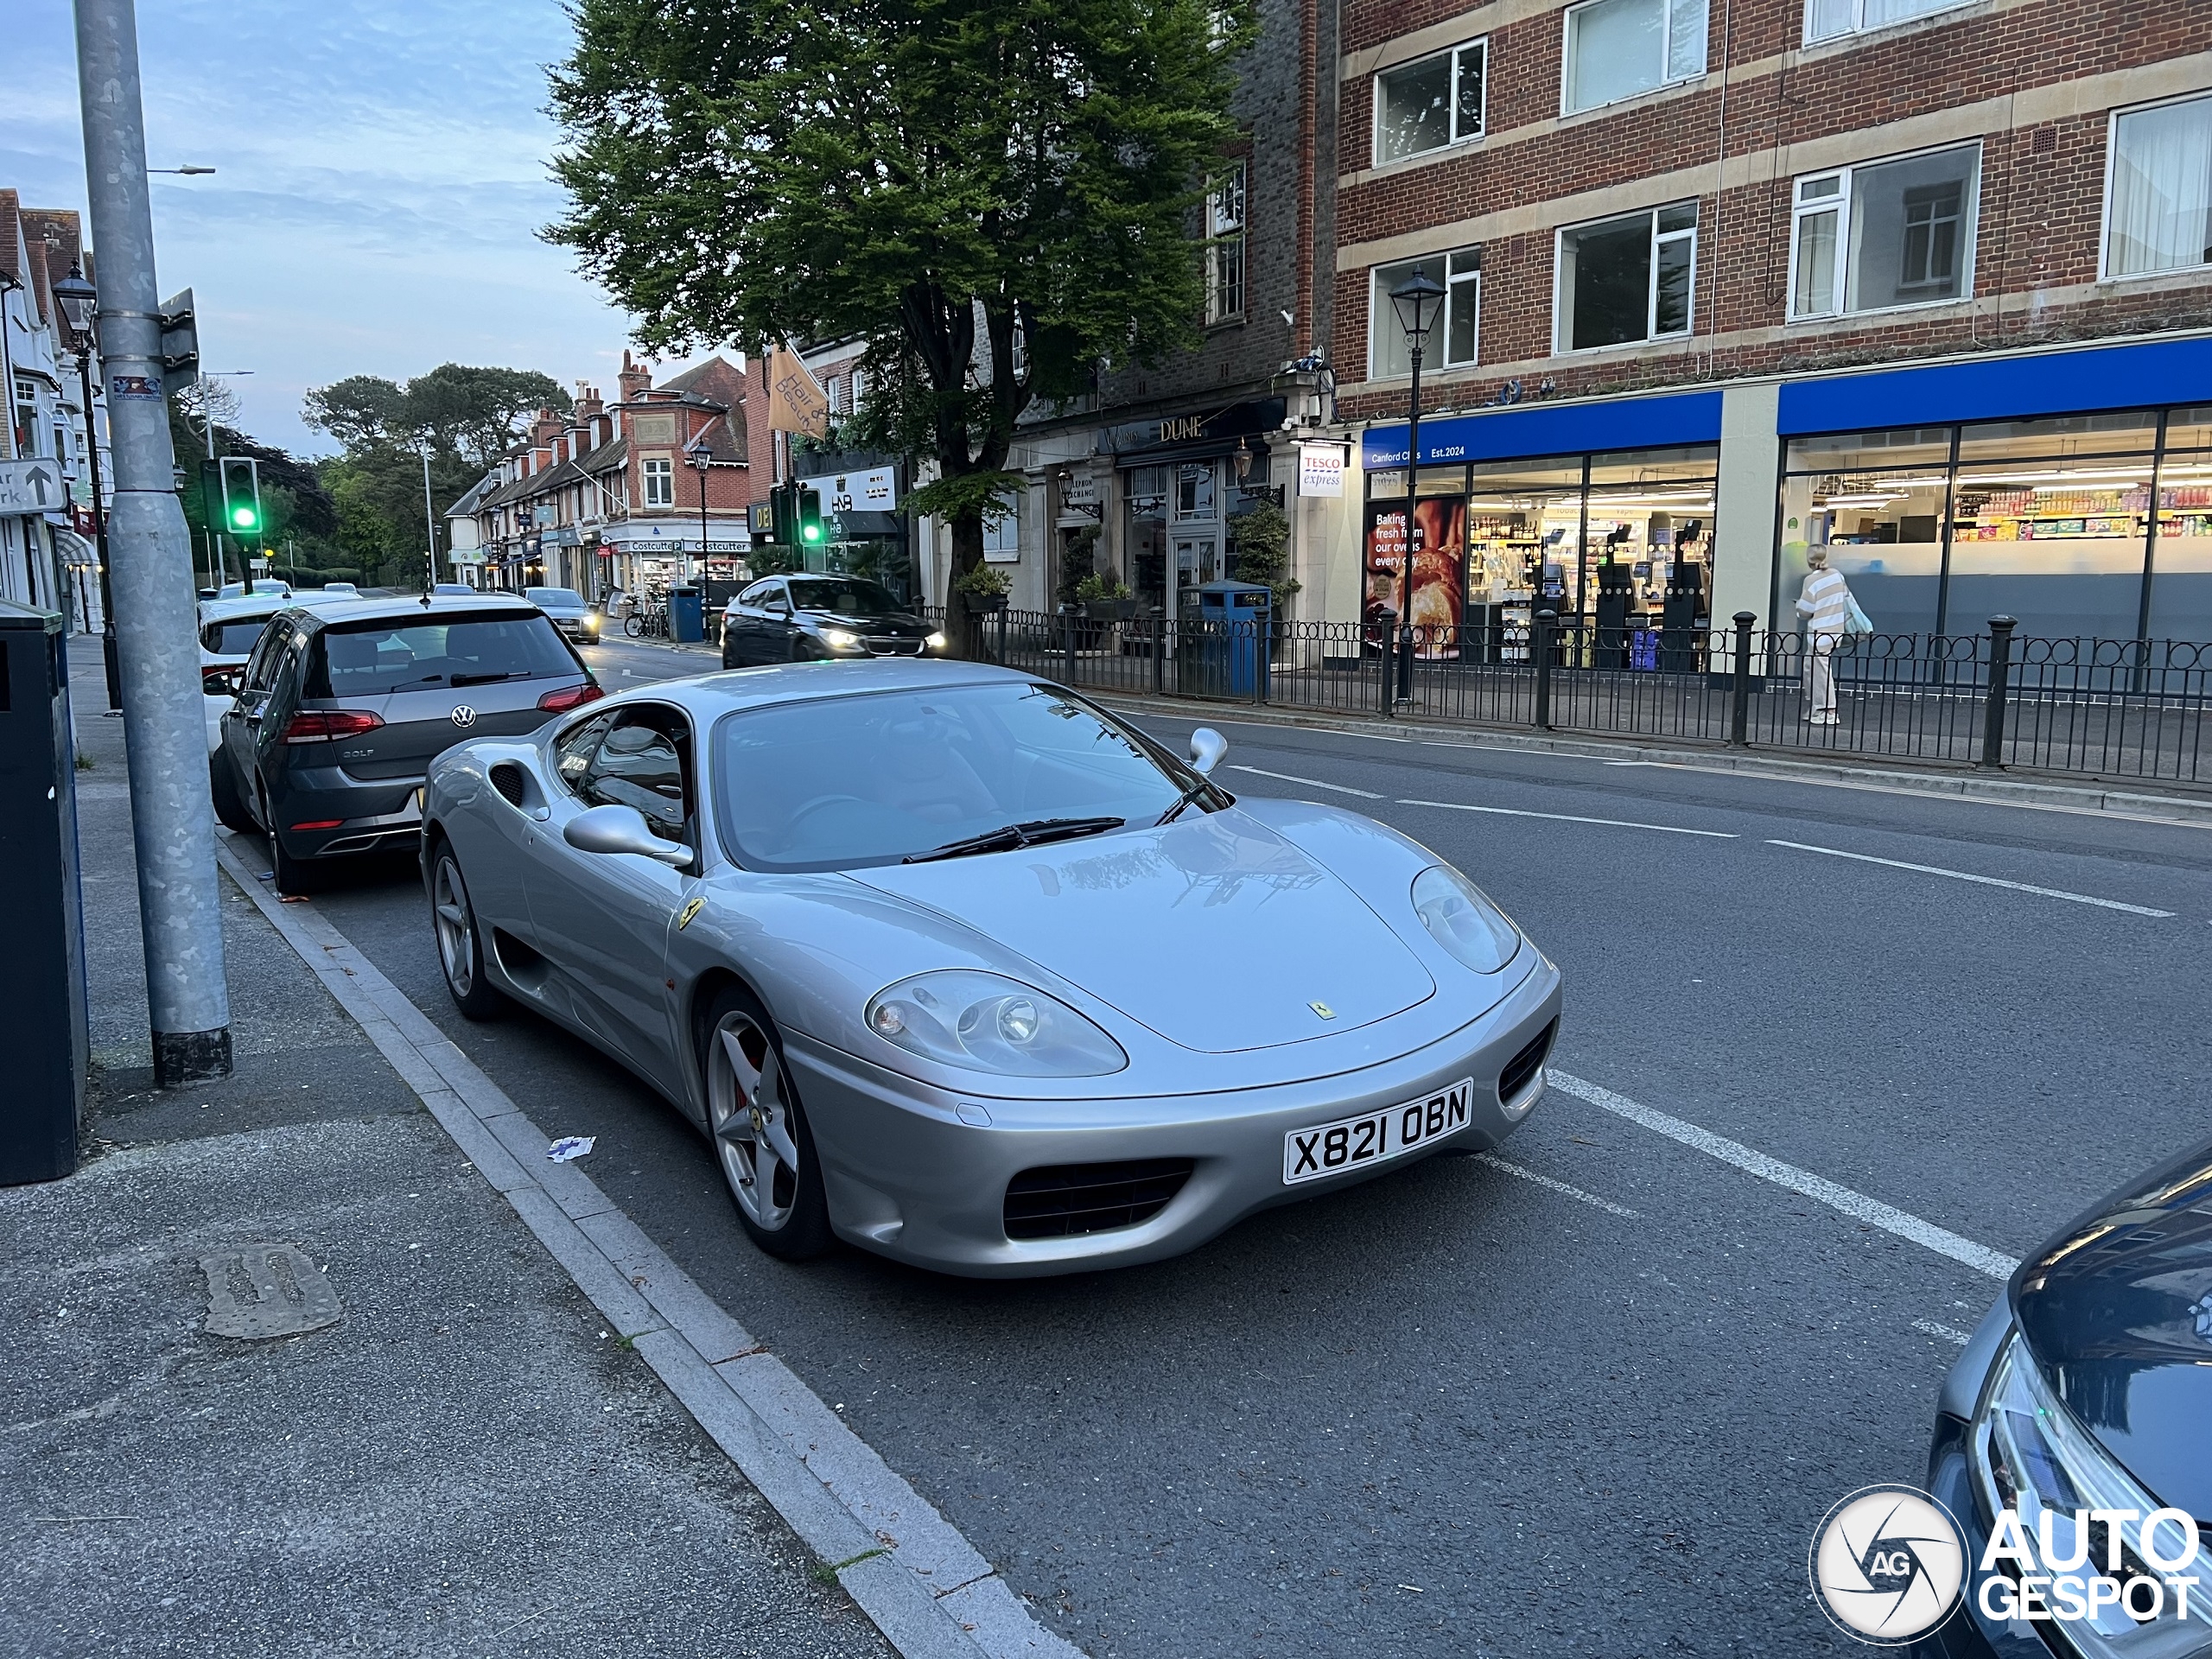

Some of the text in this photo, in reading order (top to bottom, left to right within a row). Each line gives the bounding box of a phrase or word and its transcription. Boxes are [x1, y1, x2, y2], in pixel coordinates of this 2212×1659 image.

[786, 373, 826, 423] Hair &
[1160, 415, 1202, 442] DUNE
[1371, 452, 1401, 463] Canford
[1402, 450, 1421, 461] Cls
[1304, 457, 1340, 469] TESCO
[1304, 474, 1340, 486] express
[1376, 513, 1406, 527] Baking
[830, 522, 842, 534] HNB
[1376, 527, 1423, 539] fresh frm
[632, 542, 672, 550] Costcutte
[695, 542, 747, 551] Cstcutter
[1375, 543, 1393, 553] our
[1375, 556, 1401, 569] every
[343, 749, 374, 758] GOLF
[1294, 1085, 1467, 1175] X821 OBN
